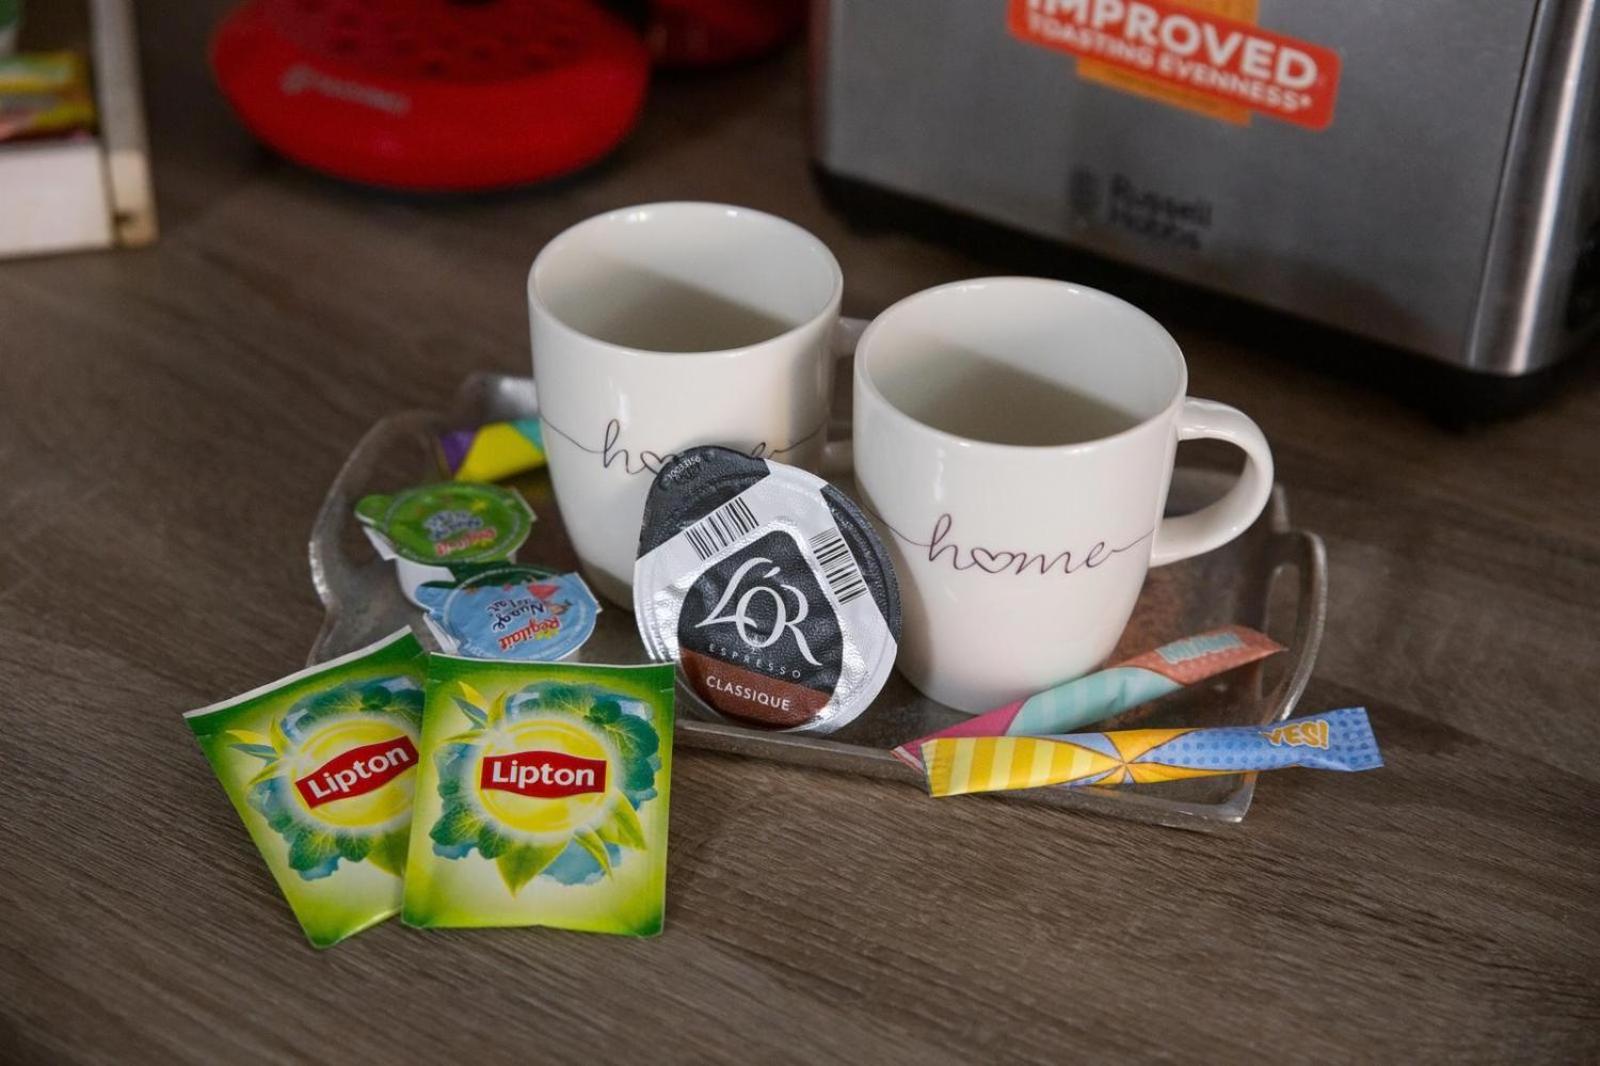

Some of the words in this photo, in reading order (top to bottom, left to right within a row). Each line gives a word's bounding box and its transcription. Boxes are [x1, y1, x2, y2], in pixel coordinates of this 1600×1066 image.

[1027, 10, 1156, 68] TOASTING
[1028, 0, 1319, 88] MPROVED
[928, 513, 1116, 575] home
[492, 602, 545, 631] Nuage
[708, 642, 802, 681] ESPRESSO
[705, 674, 792, 713] CLASSIQUE
[308, 743, 410, 800] Lipton
[491, 760, 596, 787] Lipton
